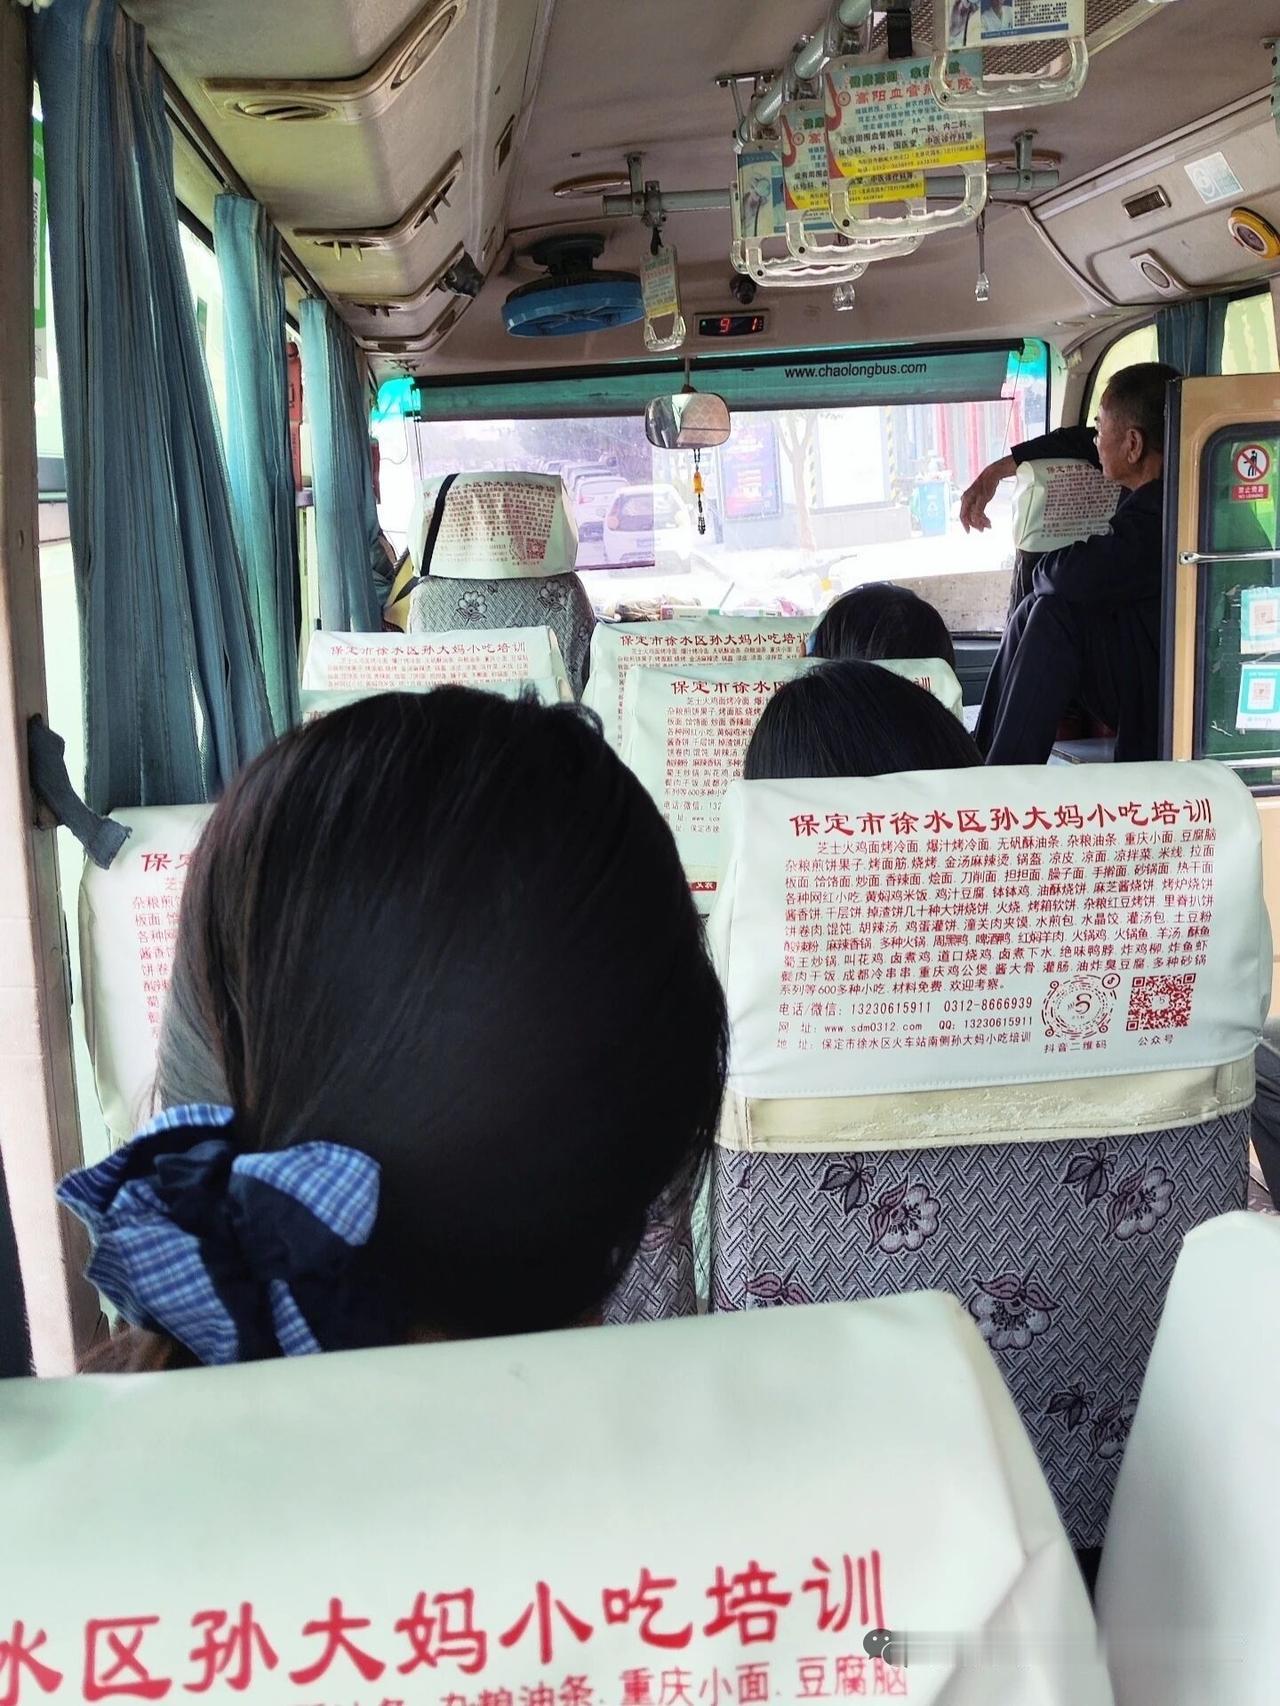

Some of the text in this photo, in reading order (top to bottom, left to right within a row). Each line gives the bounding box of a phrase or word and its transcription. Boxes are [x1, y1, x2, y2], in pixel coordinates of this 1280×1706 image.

[784, 363, 927, 378] www.chaolongbus.com
[789, 800, 1212, 837] 保定市徐水区孙大妈小吃培训
[1190, 843, 1214, 859] 拉面
[851, 1000, 930, 1016] 13230615911
[943, 996, 1032, 1012] 0312-8666939
[824, 1018, 922, 1034] www.sdm0312.com
[964, 1013, 1032, 1028] 13230615911
[1043, 1039, 1107, 1052] 抖音二维码
[1138, 1032, 1173, 1045] 公众号
